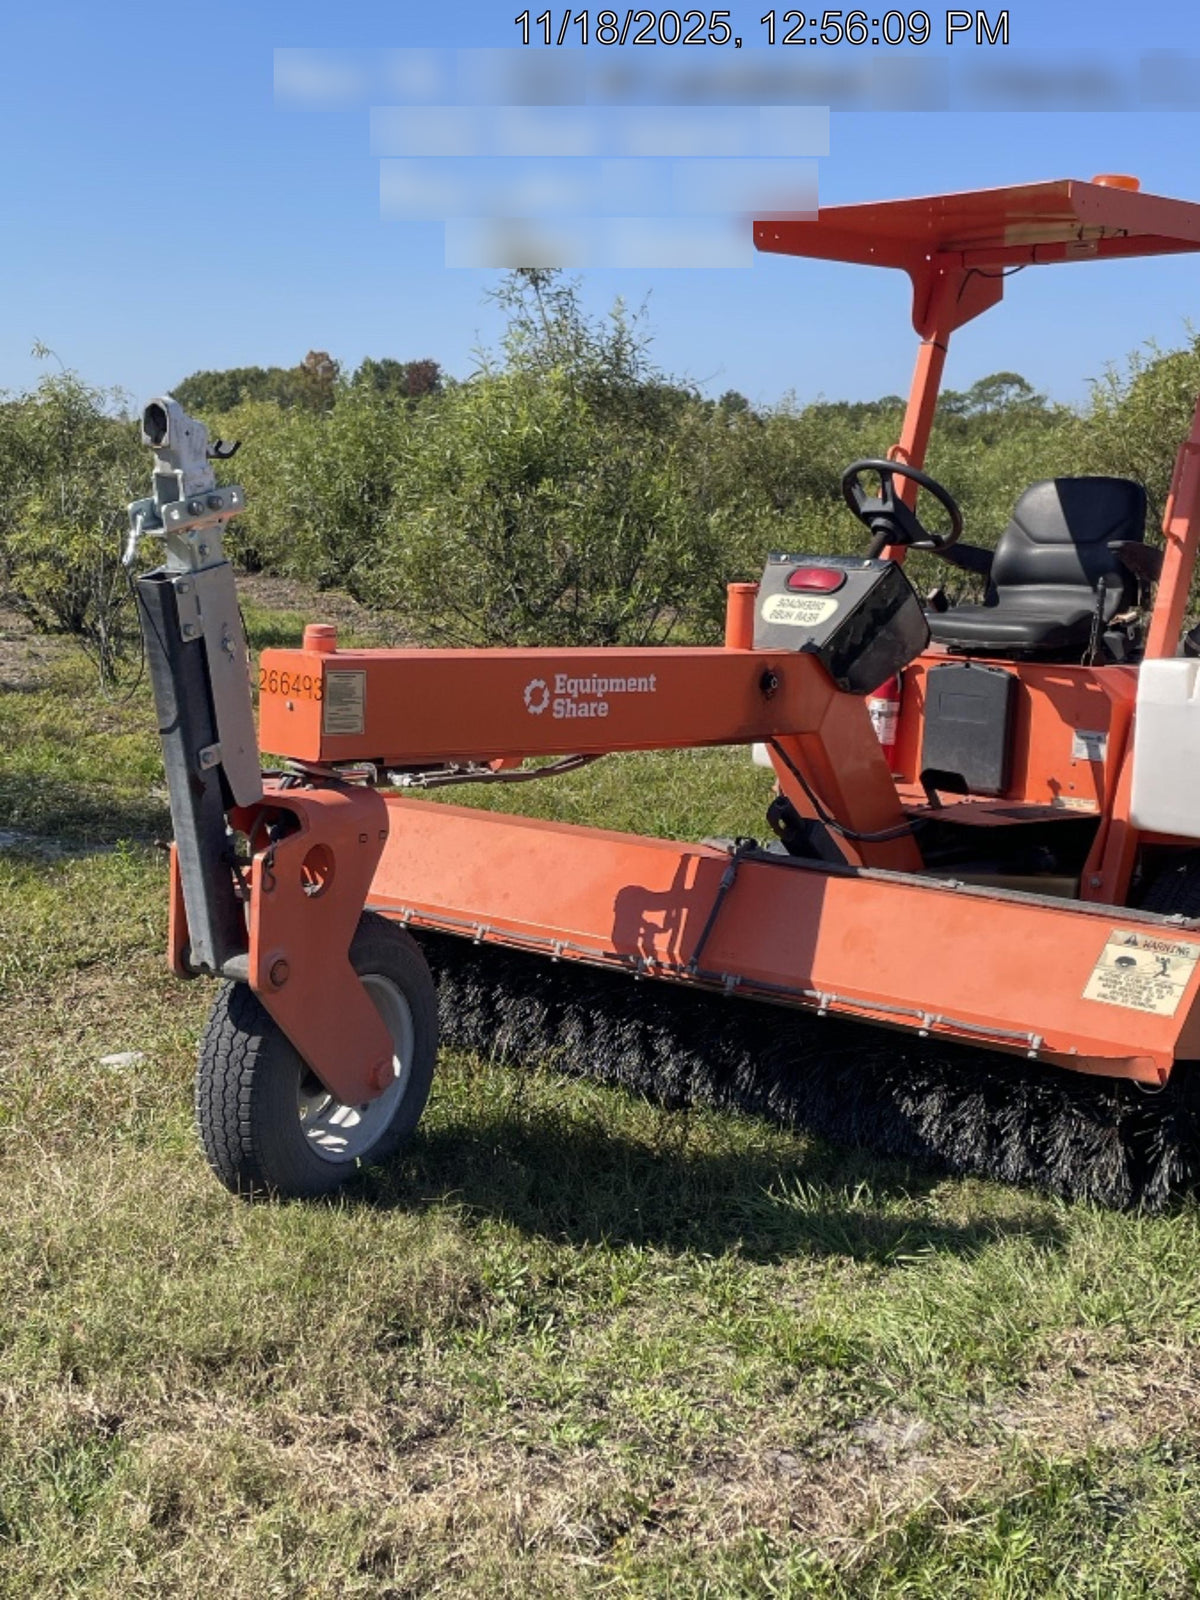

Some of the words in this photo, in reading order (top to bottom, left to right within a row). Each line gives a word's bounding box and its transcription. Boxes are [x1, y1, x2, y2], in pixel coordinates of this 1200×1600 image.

[259, 667, 324, 701] 266493
[554, 673, 657, 698] Equipment
[552, 698, 609, 719] Share
[1143, 940, 1190, 956] WARNING
